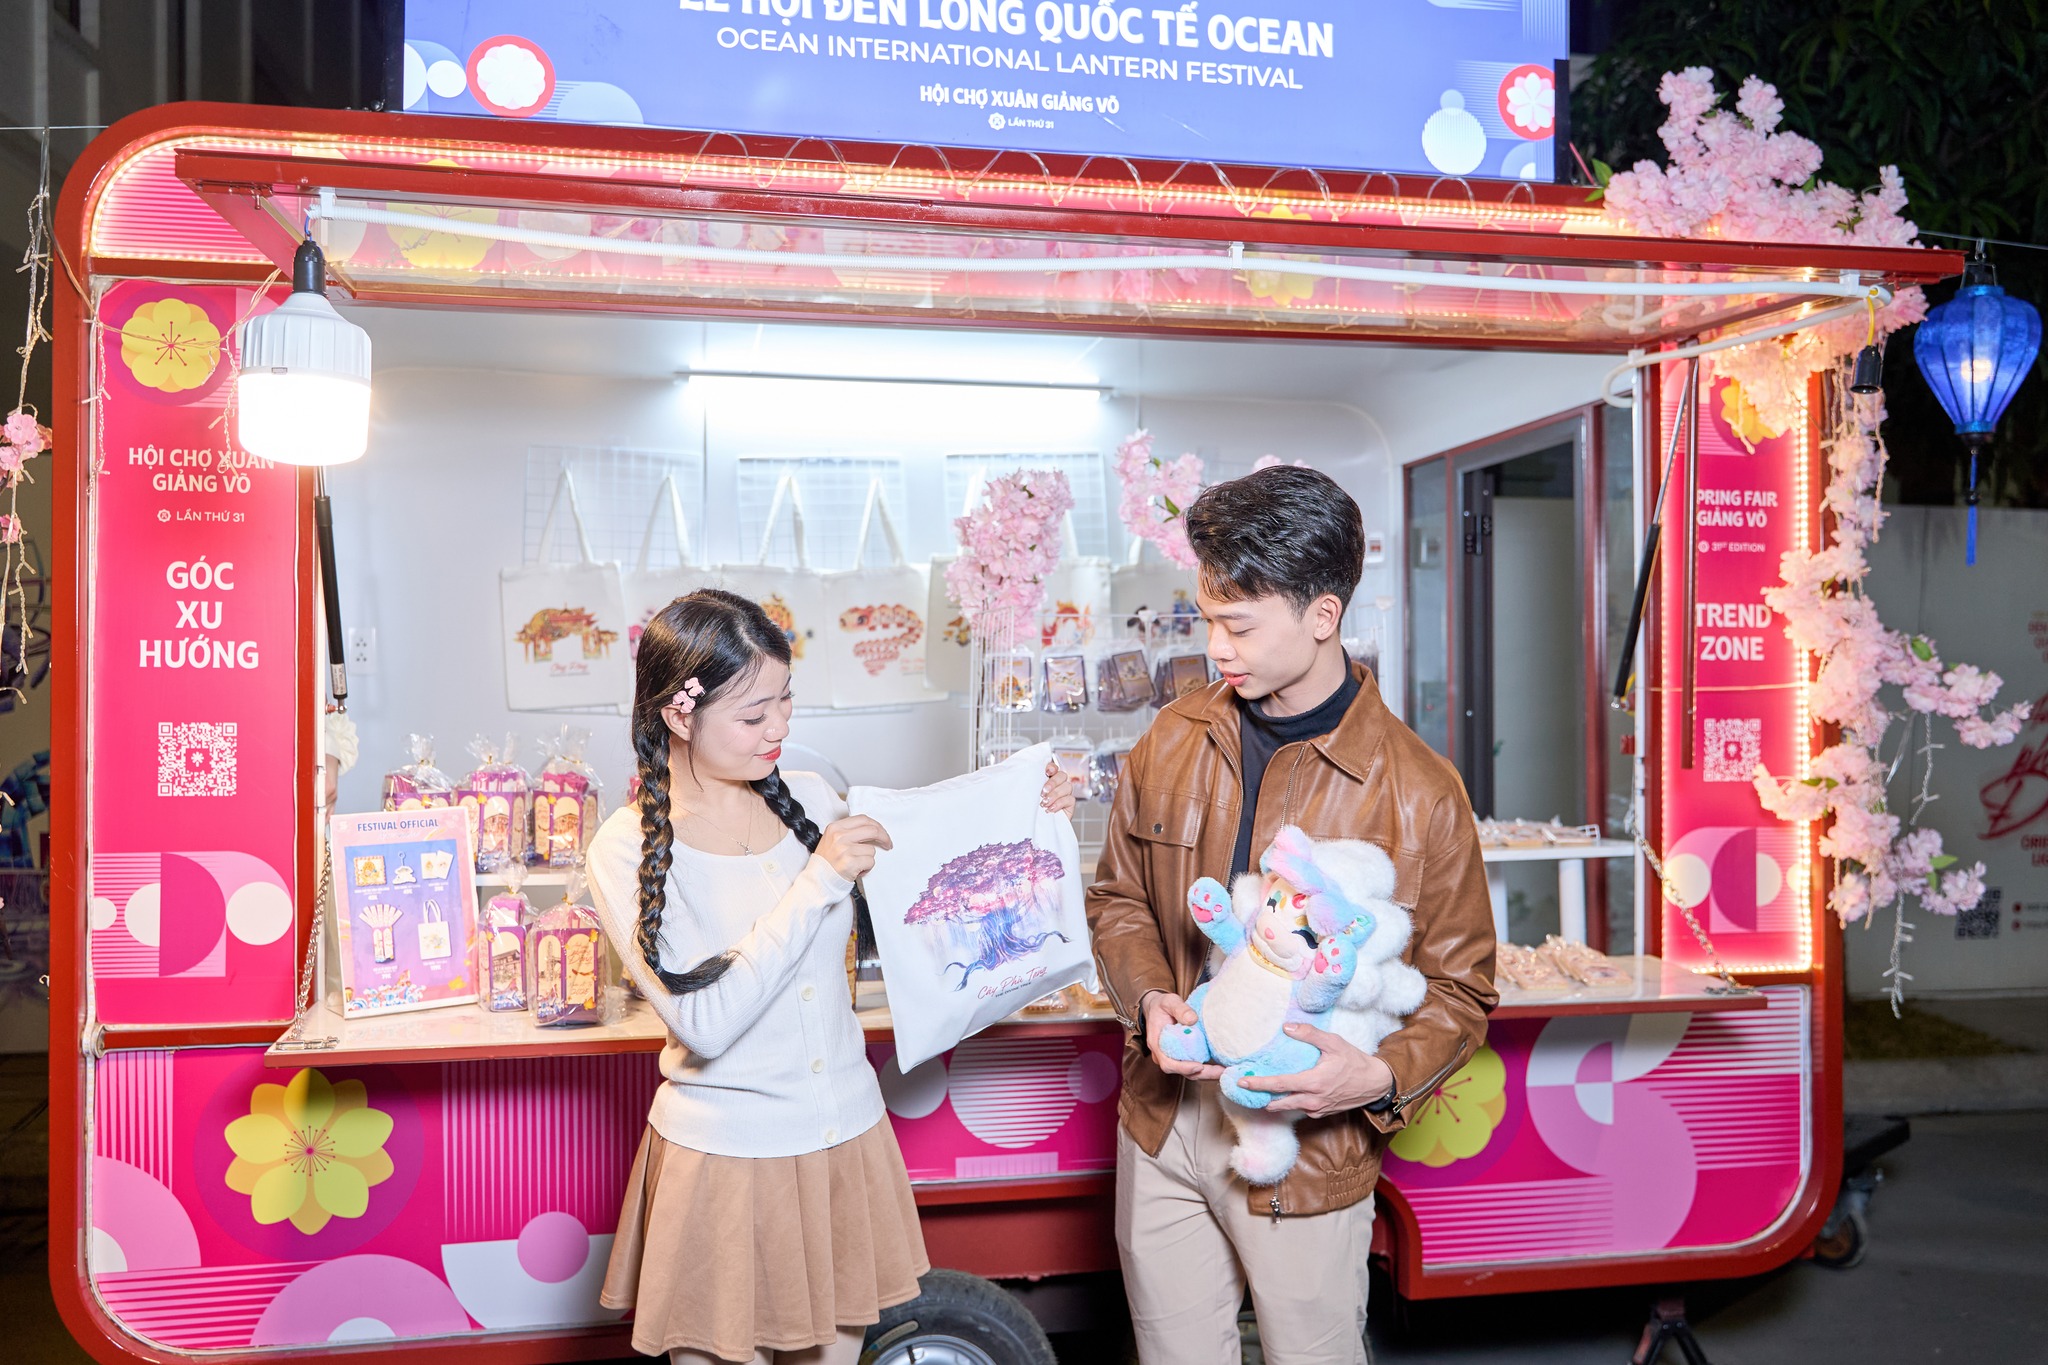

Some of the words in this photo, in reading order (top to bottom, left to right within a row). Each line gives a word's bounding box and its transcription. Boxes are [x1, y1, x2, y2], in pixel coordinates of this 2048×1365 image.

[1151, 1, 1199, 48] TẾ
[1207, 13, 1334, 58] OCEAN
[717, 26, 818, 55] OCEAN
[828, 35, 1050, 72] INTERNATIONAL
[1056, 52, 1178, 81] LANTERN
[1186, 61, 1303, 90] FESTIVAL
[920, 83, 949, 106] HỘI
[952, 87, 988, 109] CHỢ
[991, 89, 1038, 109] XUÂN
[1041, 91, 1093, 113] GIẢNG
[1096, 95, 1120, 114] VÕ
[1045, 120, 1055, 129] 31
[128, 444, 164, 470] HỘI
[169, 448, 213, 472] CHỢ
[152, 468, 217, 493] GIẢNG
[223, 472, 251, 494] VÕ
[1697, 489, 1742, 506] PRING
[1743, 490, 1778, 508] FAIR
[204, 510, 230, 522] THỨ
[232, 512, 245, 523] 31
[1728, 541, 1766, 552] EDITION
[166, 555, 235, 591] GÓC
[175, 600, 223, 629] XU
[1696, 602, 1773, 629] TREND
[139, 633, 259, 669] HƯỚNG
[1700, 635, 1765, 661] ZONE
[357, 821, 397, 832] FESTIVAL
[400, 818, 439, 829] OFFICIAL
